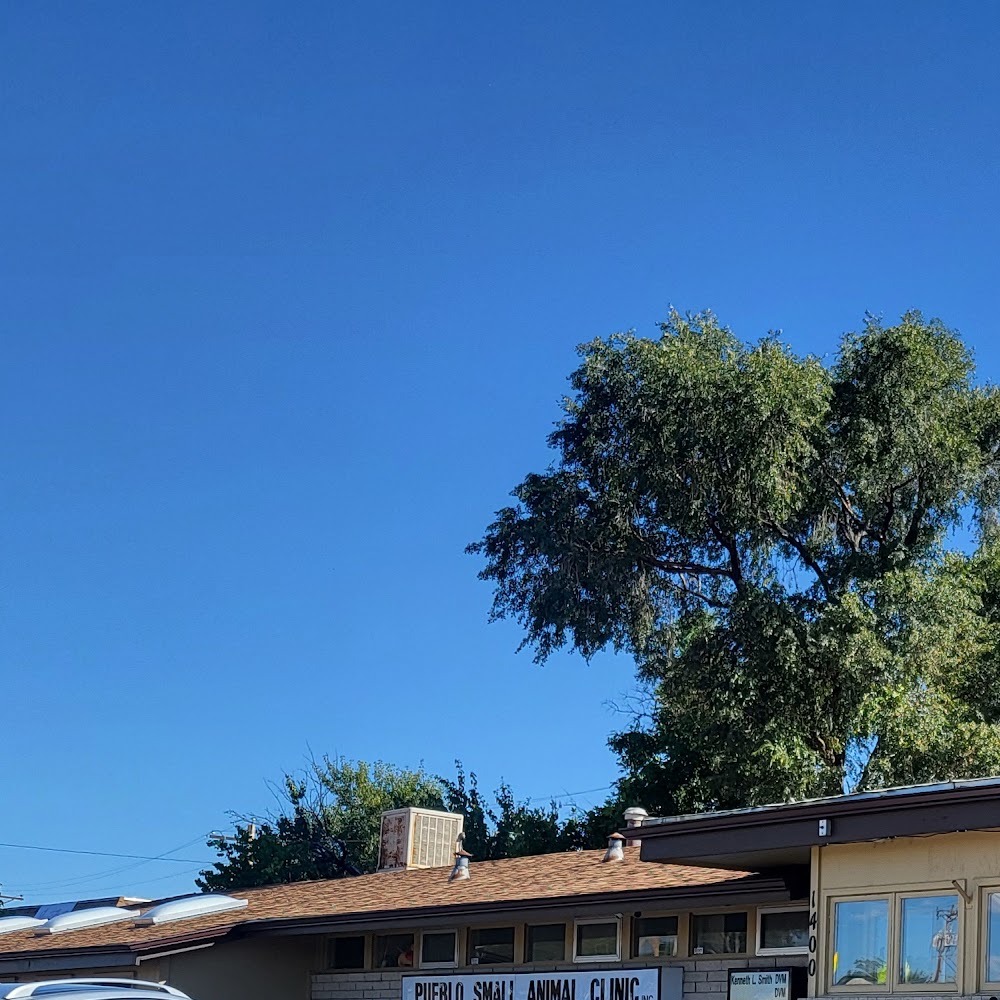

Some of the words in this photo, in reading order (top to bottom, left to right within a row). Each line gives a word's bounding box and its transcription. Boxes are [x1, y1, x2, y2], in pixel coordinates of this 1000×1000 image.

[809, 890, 817, 977] 1400
[731, 975, 750, 985] Kenneth
[758, 974, 773, 985] Smith
[774, 973, 787, 985] DVM
[774, 987, 787, 998] DVM
